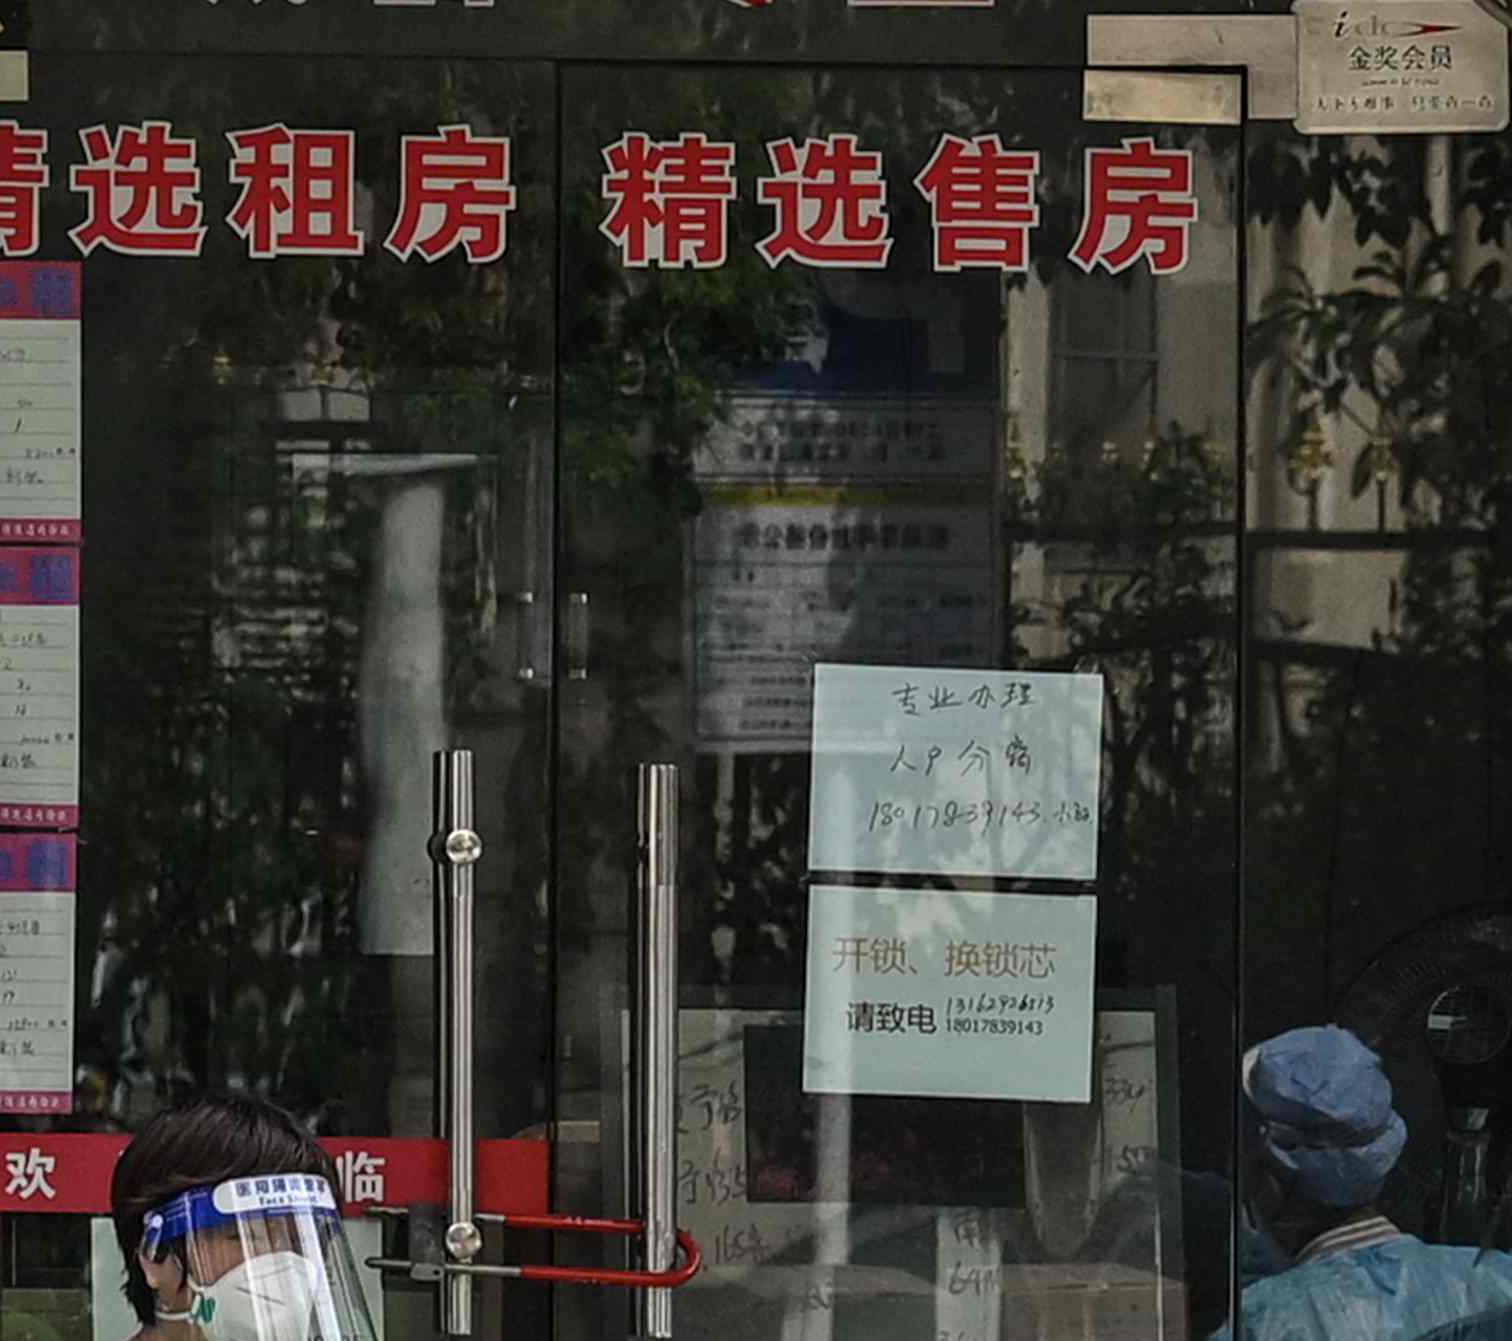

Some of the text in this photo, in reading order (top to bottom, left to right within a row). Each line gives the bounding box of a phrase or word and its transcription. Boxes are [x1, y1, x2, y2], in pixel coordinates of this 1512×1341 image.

[1349, 45, 1452, 71] 金奖会员
[601, 131, 1198, 275] 精选售房
[892, 683, 1035, 716] 专业办理
[945, 941, 1057, 978] 换锁芯
[846, 1002, 937, 1034] 请致电
[946, 1018, 1043, 1036] 18017839143
[3, 1150, 386, 1202] 欢临
